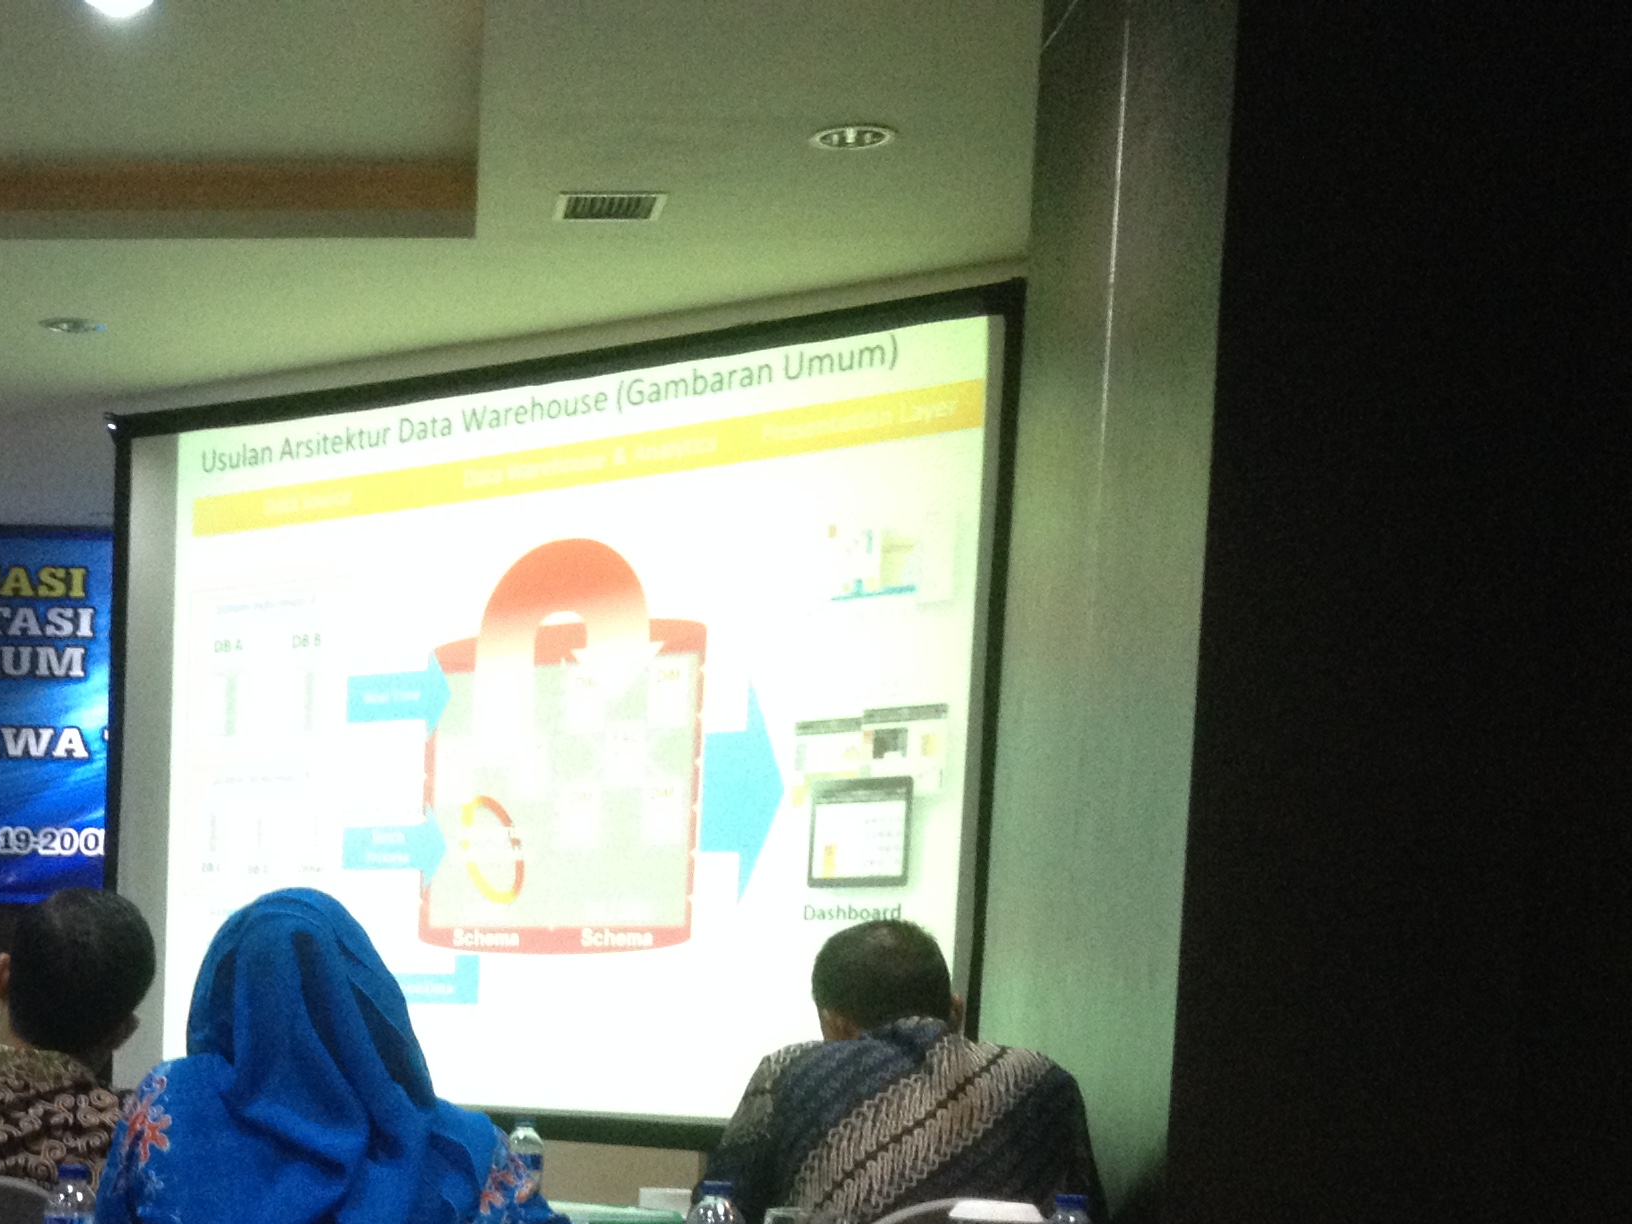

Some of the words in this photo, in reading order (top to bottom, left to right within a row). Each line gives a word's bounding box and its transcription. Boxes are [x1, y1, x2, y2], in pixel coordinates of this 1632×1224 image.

[201, 443, 274, 474] Usulan
[279, 425, 392, 461] Arsitektur
[397, 417, 453, 443] Data
[461, 396, 608, 433] Warehouse
[615, 361, 774, 413] (Gambaran
[783, 333, 900, 381] Umum)
[803, 902, 902, 921] Dashboard
[452, 927, 520, 946] Schema
[581, 926, 653, 947] Schema
